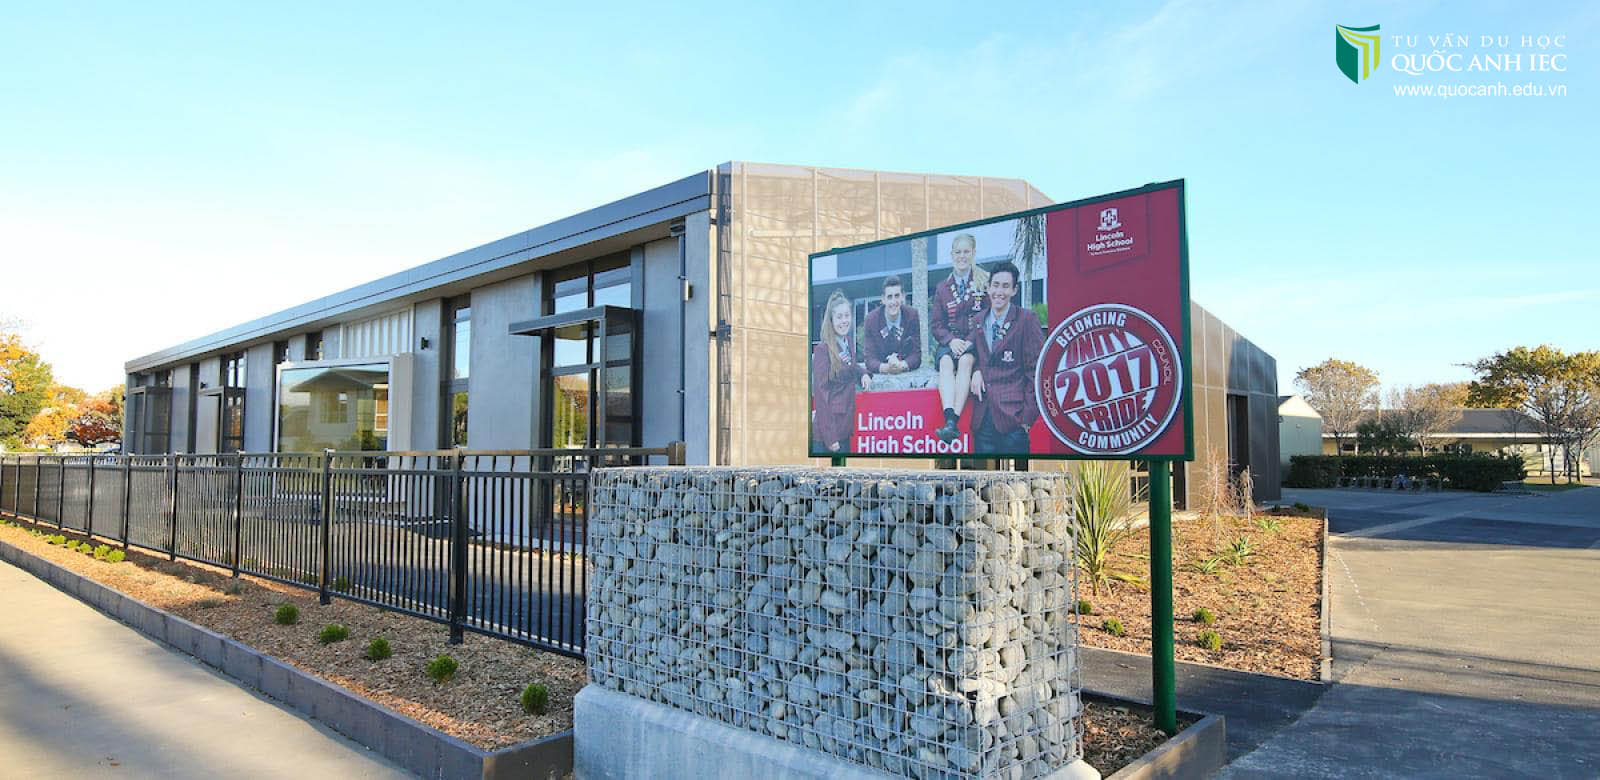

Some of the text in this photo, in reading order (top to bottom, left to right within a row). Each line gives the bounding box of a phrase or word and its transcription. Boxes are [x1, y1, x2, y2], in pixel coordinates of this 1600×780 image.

[1087, 237, 1133, 251] High School
[1095, 232, 1124, 242] Lincoln
[1056, 311, 1127, 348] BELONGING
[1065, 328, 1131, 368] UNITY
[1056, 345, 1152, 411] 2017
[1152, 339, 1173, 385] COUNCIL
[1043, 376, 1059, 417] SCHOOL
[1076, 391, 1148, 432] PRIDE
[857, 410, 924, 431] Lincoln
[1078, 413, 1159, 449] COMMUNITY
[857, 433, 969, 454] High School
